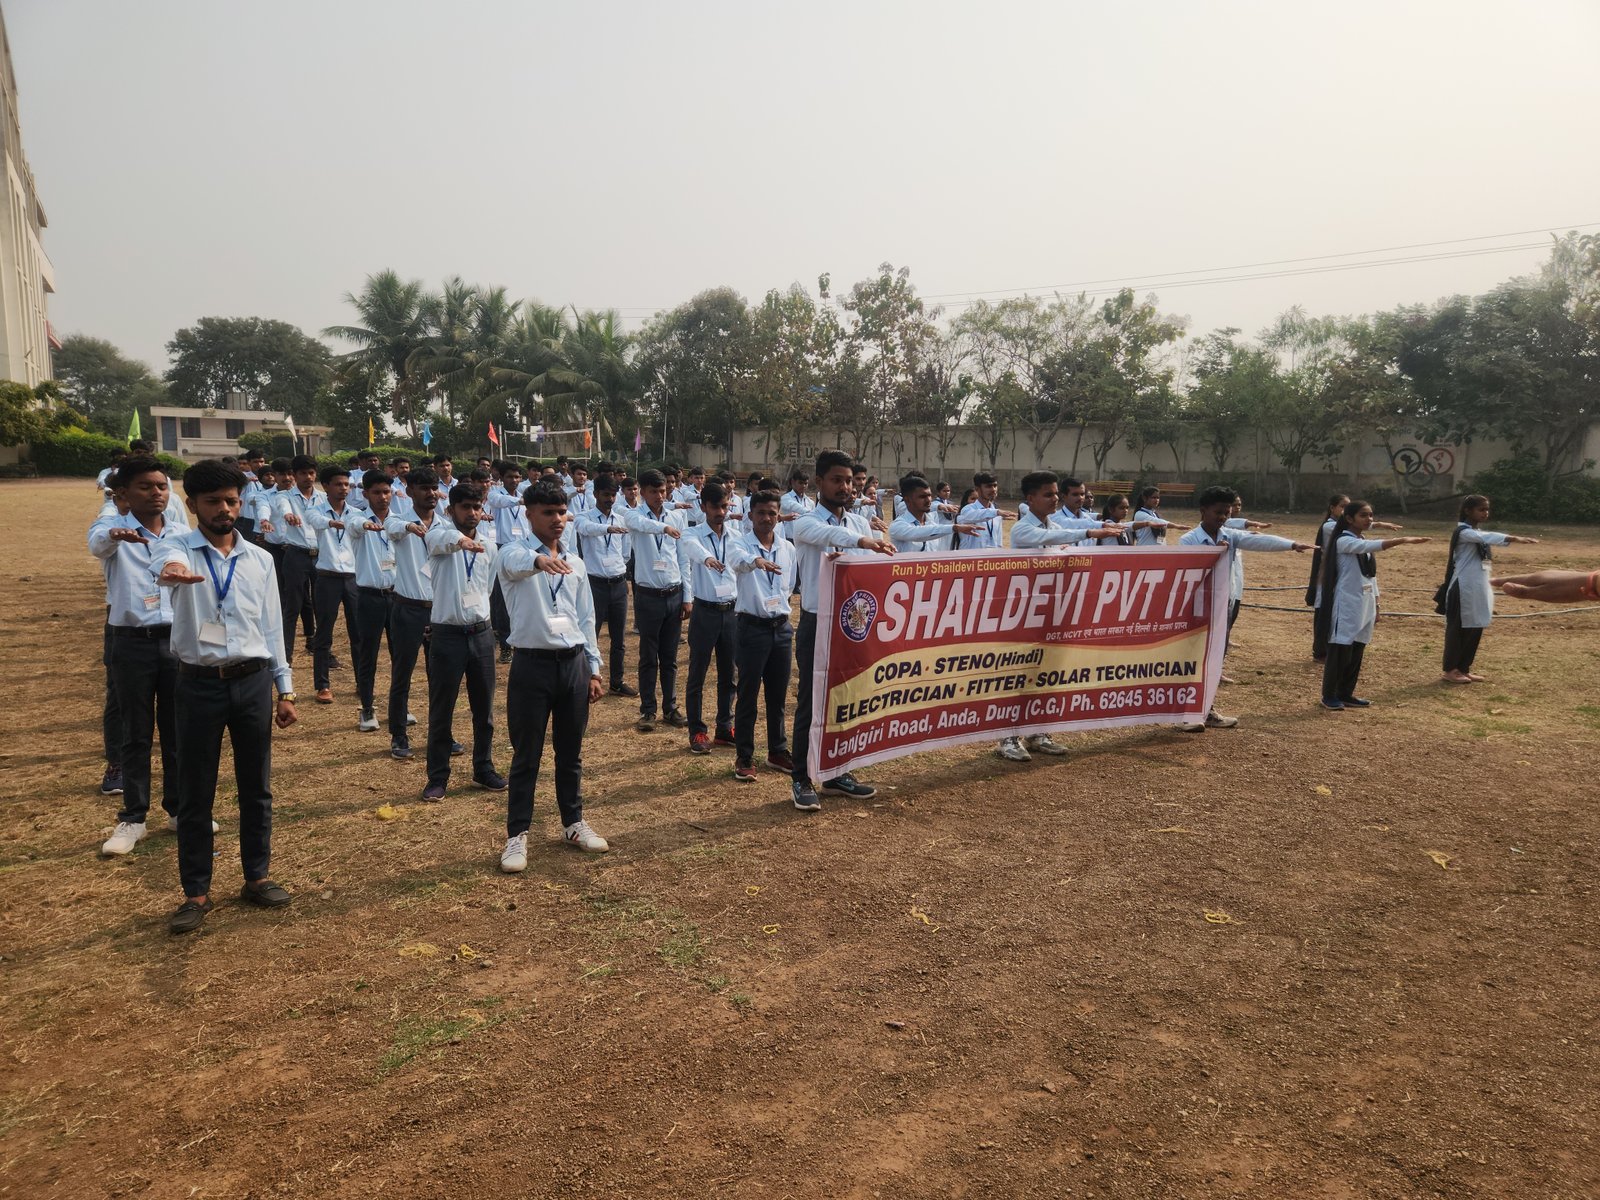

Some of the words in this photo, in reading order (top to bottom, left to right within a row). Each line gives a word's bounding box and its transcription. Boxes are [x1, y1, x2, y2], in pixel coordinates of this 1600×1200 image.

[892, 565, 912, 576] Run
[916, 564, 928, 577] by
[931, 562, 975, 574] Shaildevi
[977, 558, 1030, 571] Educational
[1068, 556, 1092, 567] Bhilai
[876, 571, 1090, 642] SHAILDEVI
[1092, 570, 1166, 624] PVT
[1063, 630, 1082, 639] NCVT
[874, 660, 922, 684] COPA
[934, 648, 1044, 675] STENO(Hindi)
[835, 683, 957, 723] ELECTRICIAN
[966, 674, 1026, 696] FITTER
[1036, 668, 1091, 687] SOLAR
[1096, 661, 1197, 682] TECHNICIAN
[828, 723, 884, 759] Janjgiri
[888, 714, 933, 738] Road,
[937, 708, 980, 729] Anda,
[985, 704, 1021, 722] Durg
[1025, 697, 1066, 719] (C.G.)
[1070, 694, 1095, 712] Ph.
[1099, 689, 1143, 710] 62645
[1147, 686, 1197, 705] 36162
